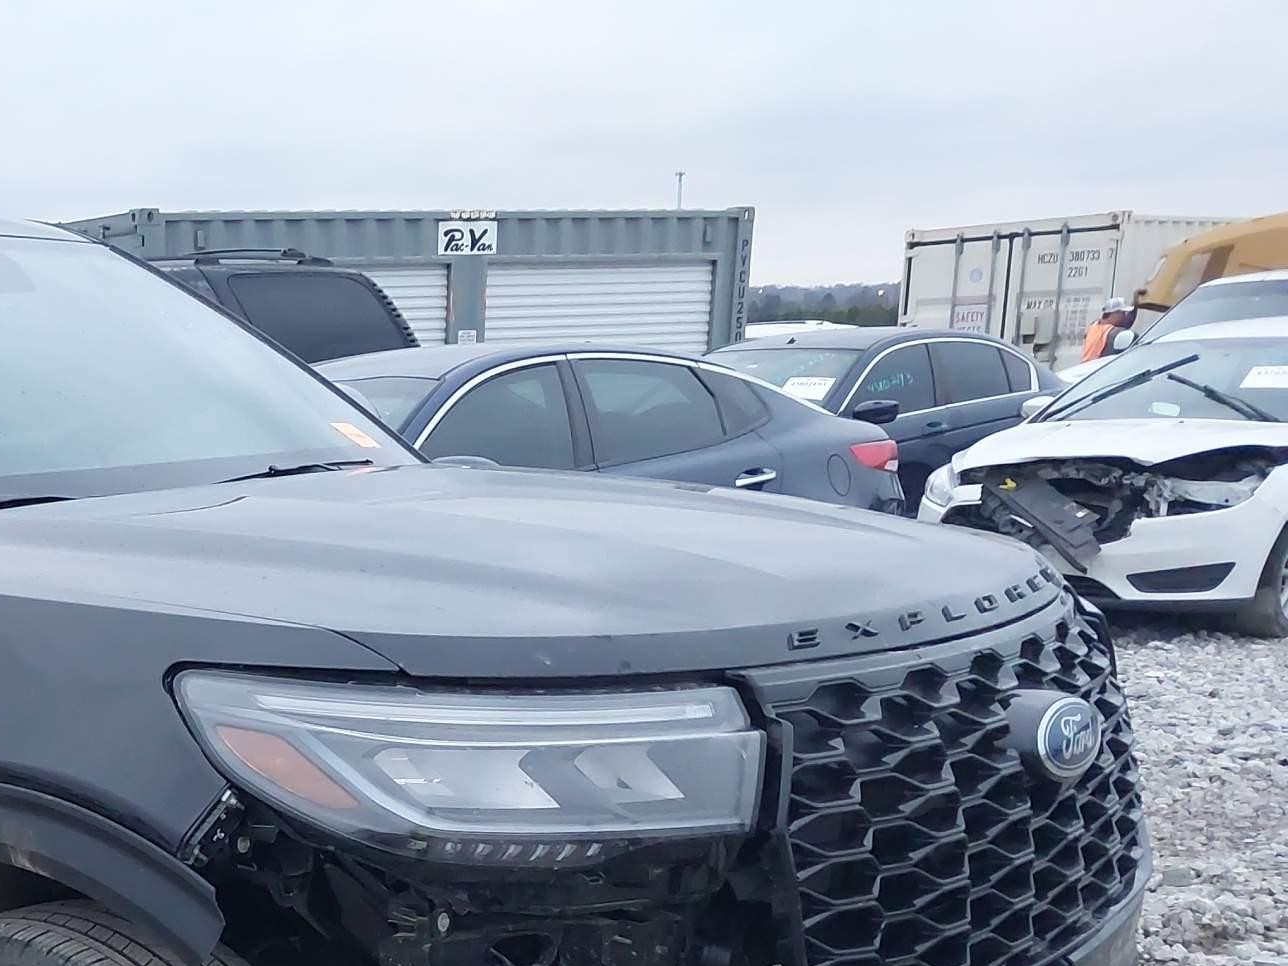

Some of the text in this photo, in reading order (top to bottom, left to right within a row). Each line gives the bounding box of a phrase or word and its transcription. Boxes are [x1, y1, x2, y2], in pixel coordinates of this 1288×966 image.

[443, 228, 493, 252] Pac-Van
[955, 311, 985, 323] SAFETY
[1060, 713, 1095, 760] Ford
